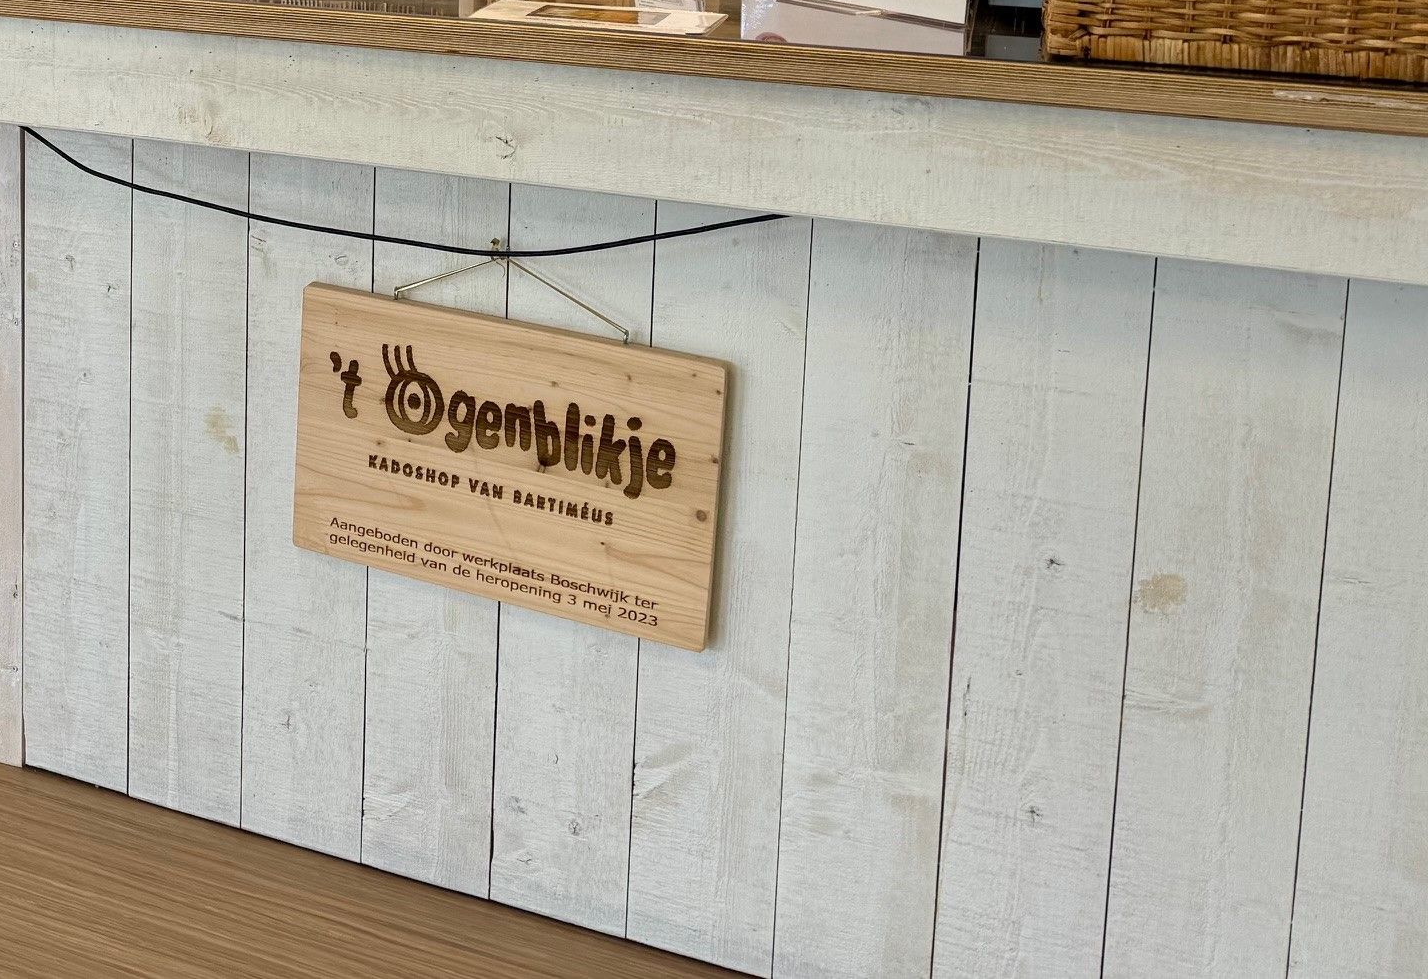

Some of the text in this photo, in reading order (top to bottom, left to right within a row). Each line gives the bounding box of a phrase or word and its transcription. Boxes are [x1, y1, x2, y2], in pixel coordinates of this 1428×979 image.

[329, 351, 362, 419] 't
[368, 455, 614, 525] KADOSHOP VAN BARTIMÉUS
[329, 533, 658, 627] gelegenheid van de heropening 3 mei 2023
[330, 517, 659, 610] Aangeboden door werkplaats Boschwijk ter
